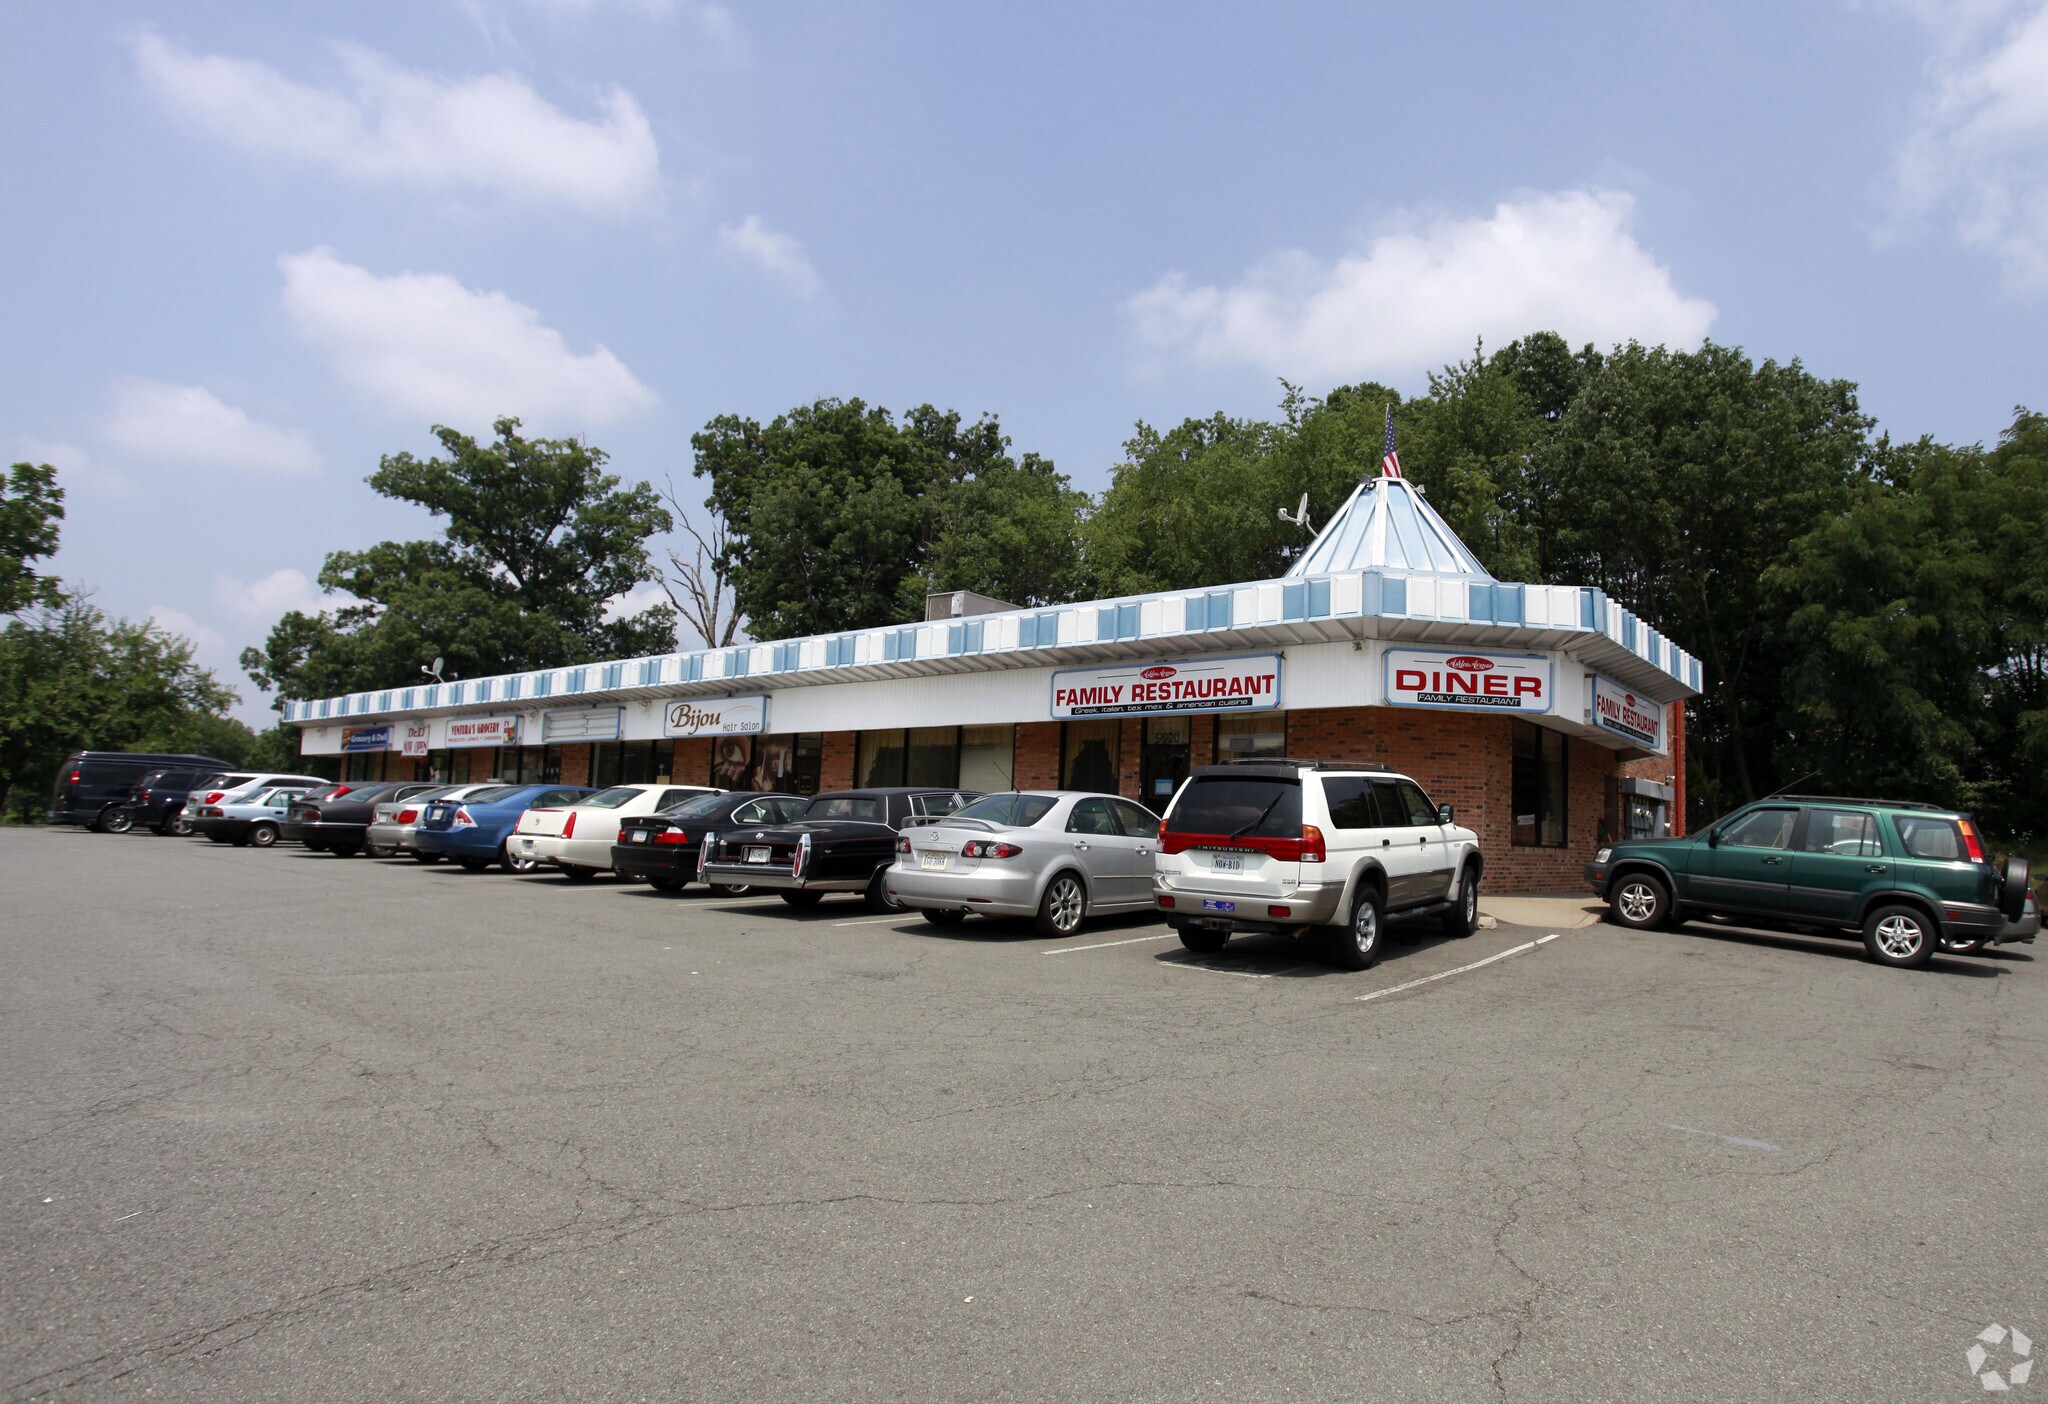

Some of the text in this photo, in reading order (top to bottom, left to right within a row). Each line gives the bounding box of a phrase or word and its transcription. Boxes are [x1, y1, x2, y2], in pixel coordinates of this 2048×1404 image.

[1396, 669, 1542, 698] DINER
[1056, 674, 1275, 707] FAMILY RESTAURANT
[1418, 693, 1520, 706] FAMILY RESTAURANT
[1074, 706, 1099, 714] Greek,
[1144, 702, 1163, 710] mex
[1176, 700, 1215, 709] american
[670, 703, 721, 735] Bijou
[1597, 694, 1621, 720] FAMILY
[1623, 706, 1658, 736] RESTAURANT
[451, 724, 476, 735] VENTURA'S
[477, 722, 500, 734] GROCERY
[722, 721, 760, 732] Hair Salon
[351, 733, 387, 743] Grocery & Deli
[1155, 732, 1180, 743] 9920
